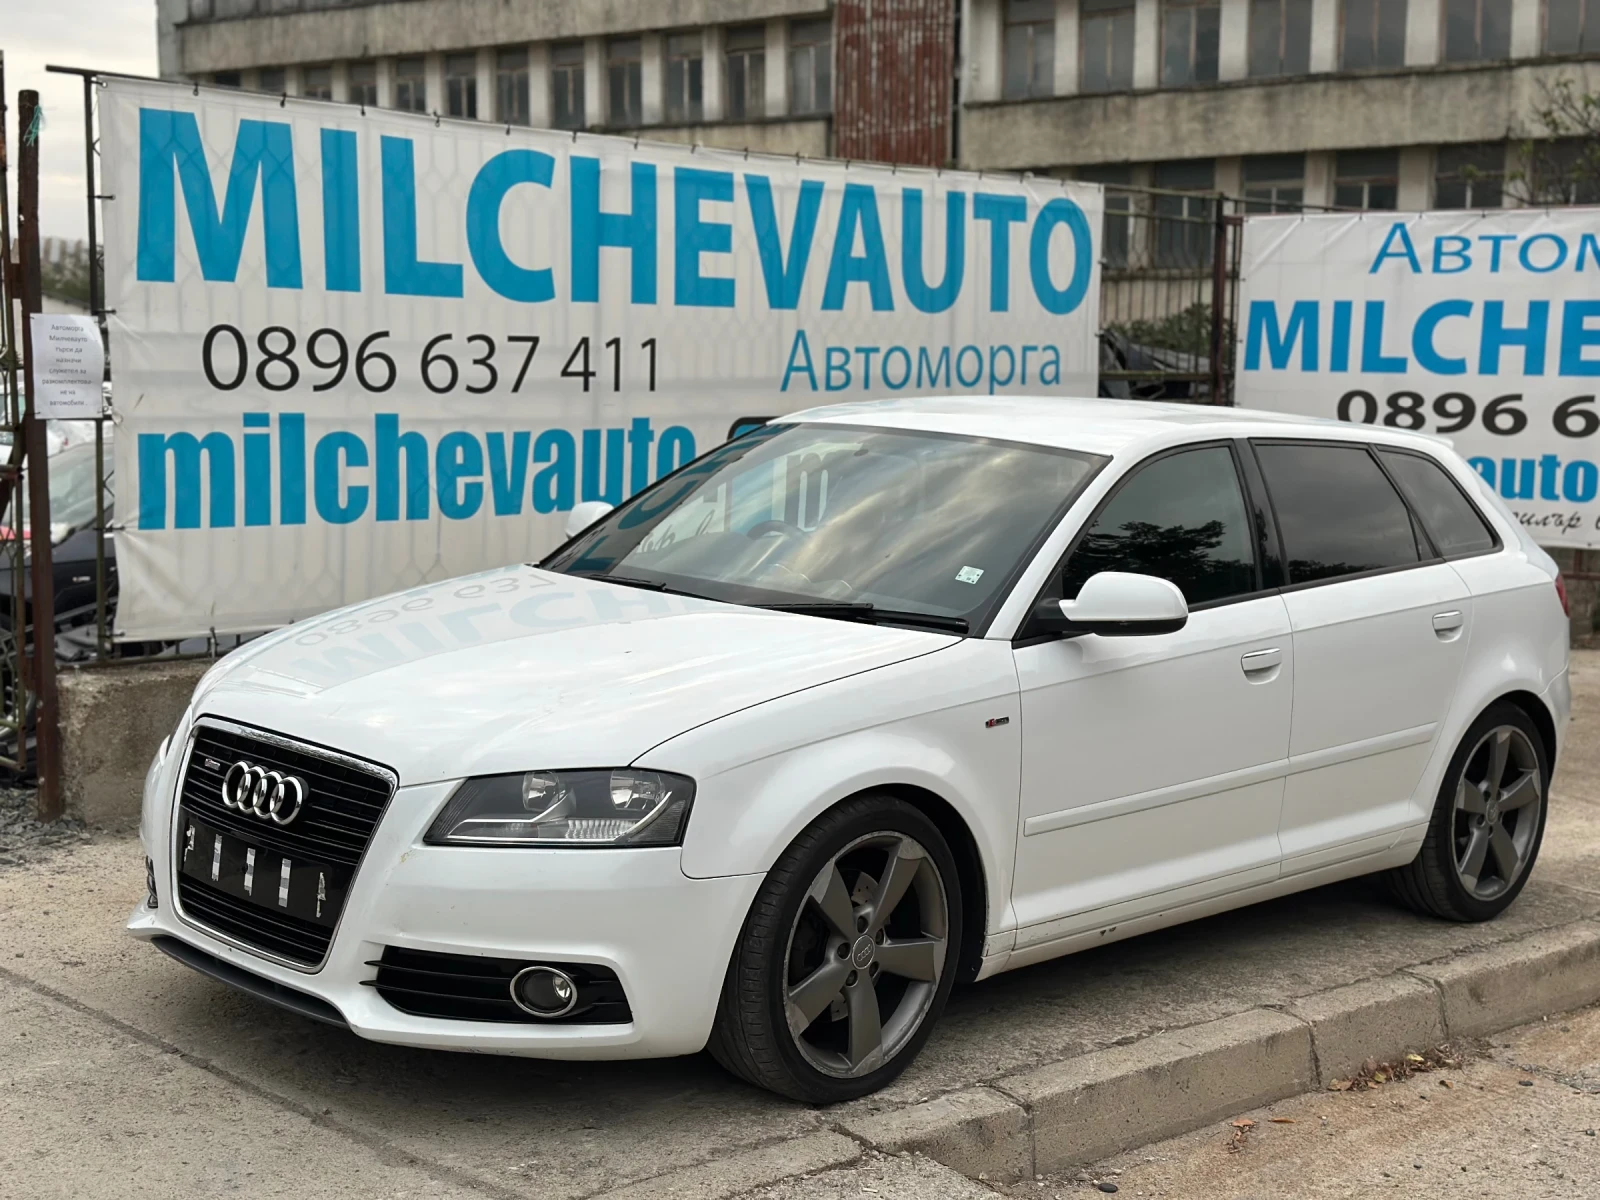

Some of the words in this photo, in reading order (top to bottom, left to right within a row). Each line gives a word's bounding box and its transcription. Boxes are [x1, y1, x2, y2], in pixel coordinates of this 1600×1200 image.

[136, 107, 1093, 315] MILCHEVAUTO
[202, 323, 396, 394] 0896
[420, 333, 540, 395] 637
[560, 336, 657, 393] 411
[780, 329, 1060, 395] Автоморга
[1336, 389, 1528, 436] 0896
[137, 412, 697, 531] milchevauto
